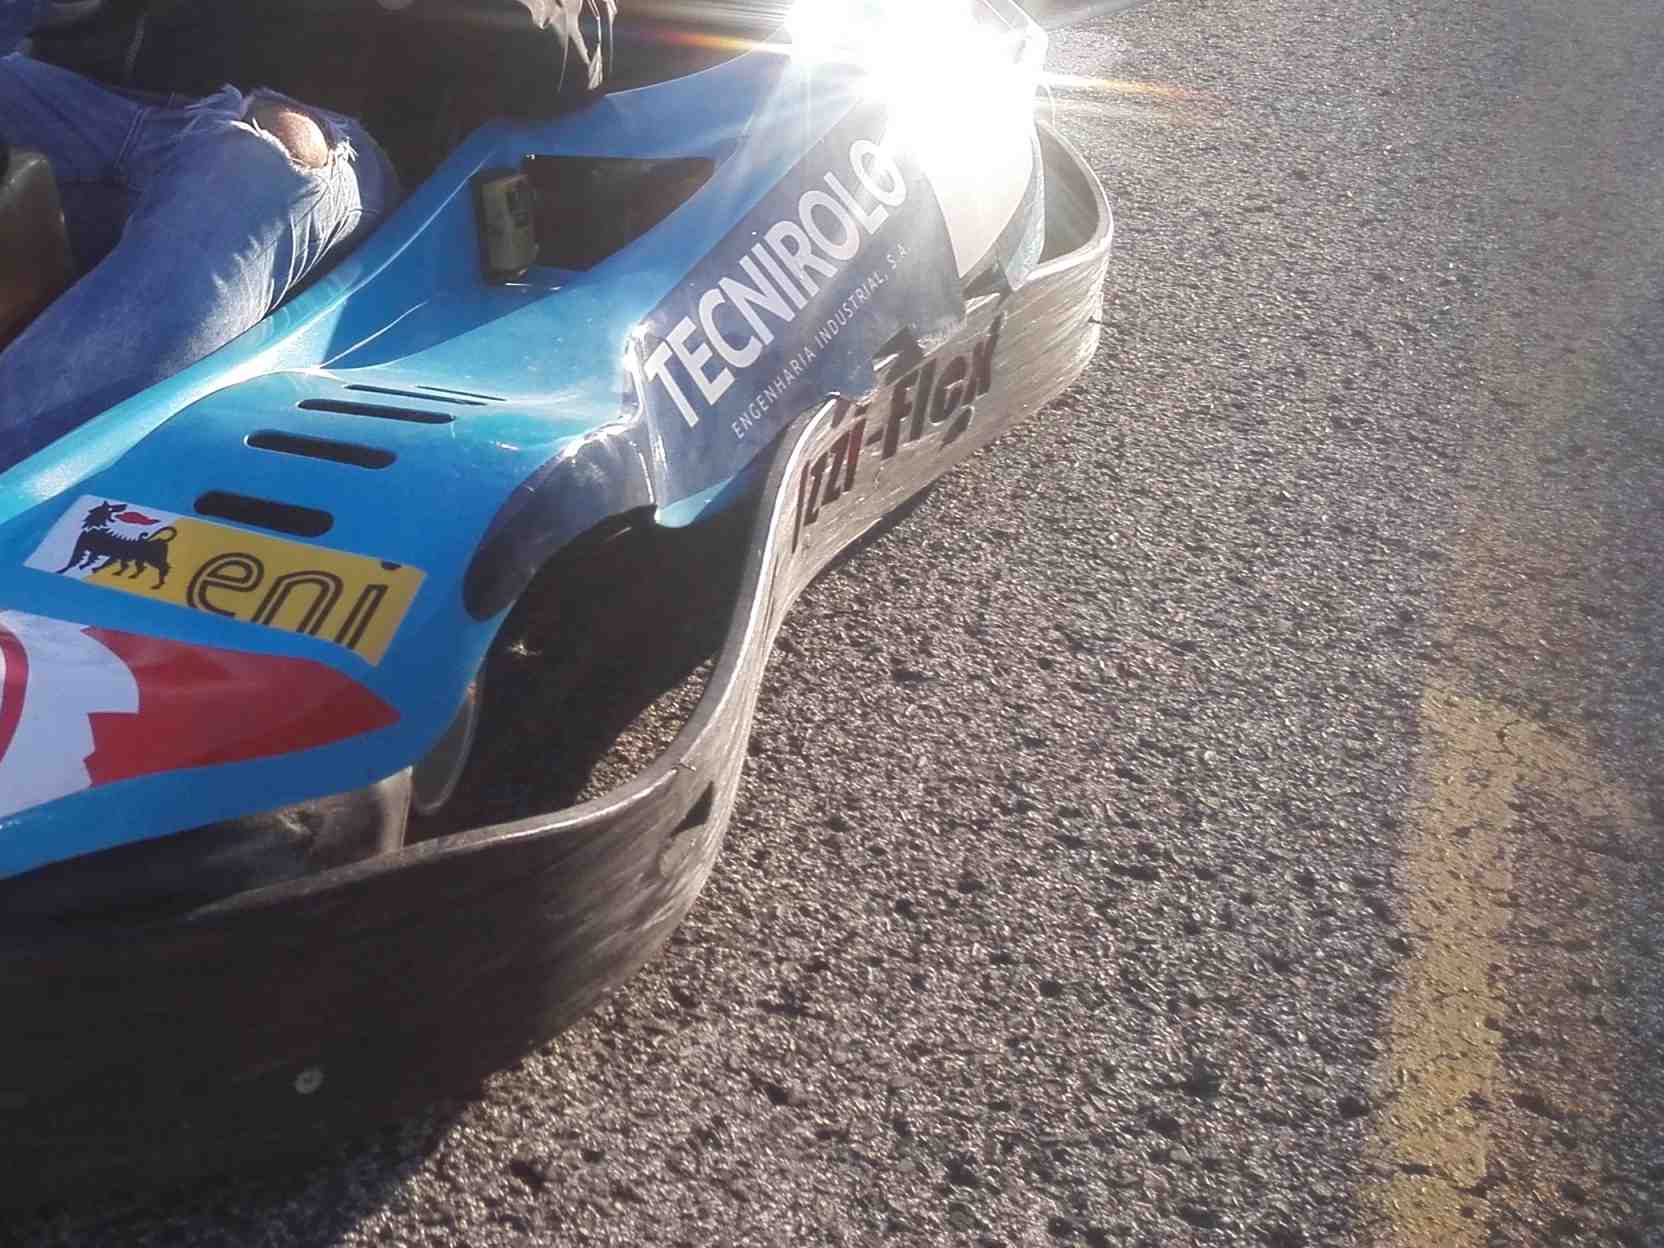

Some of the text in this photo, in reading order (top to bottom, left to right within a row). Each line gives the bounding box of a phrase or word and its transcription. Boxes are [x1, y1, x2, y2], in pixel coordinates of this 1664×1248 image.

[643, 139, 907, 430] TECNIROLO
[731, 346, 816, 441] ENGENHARIA
[815, 267, 890, 352] INDUSTRIAL,
[186, 552, 402, 650] eni
